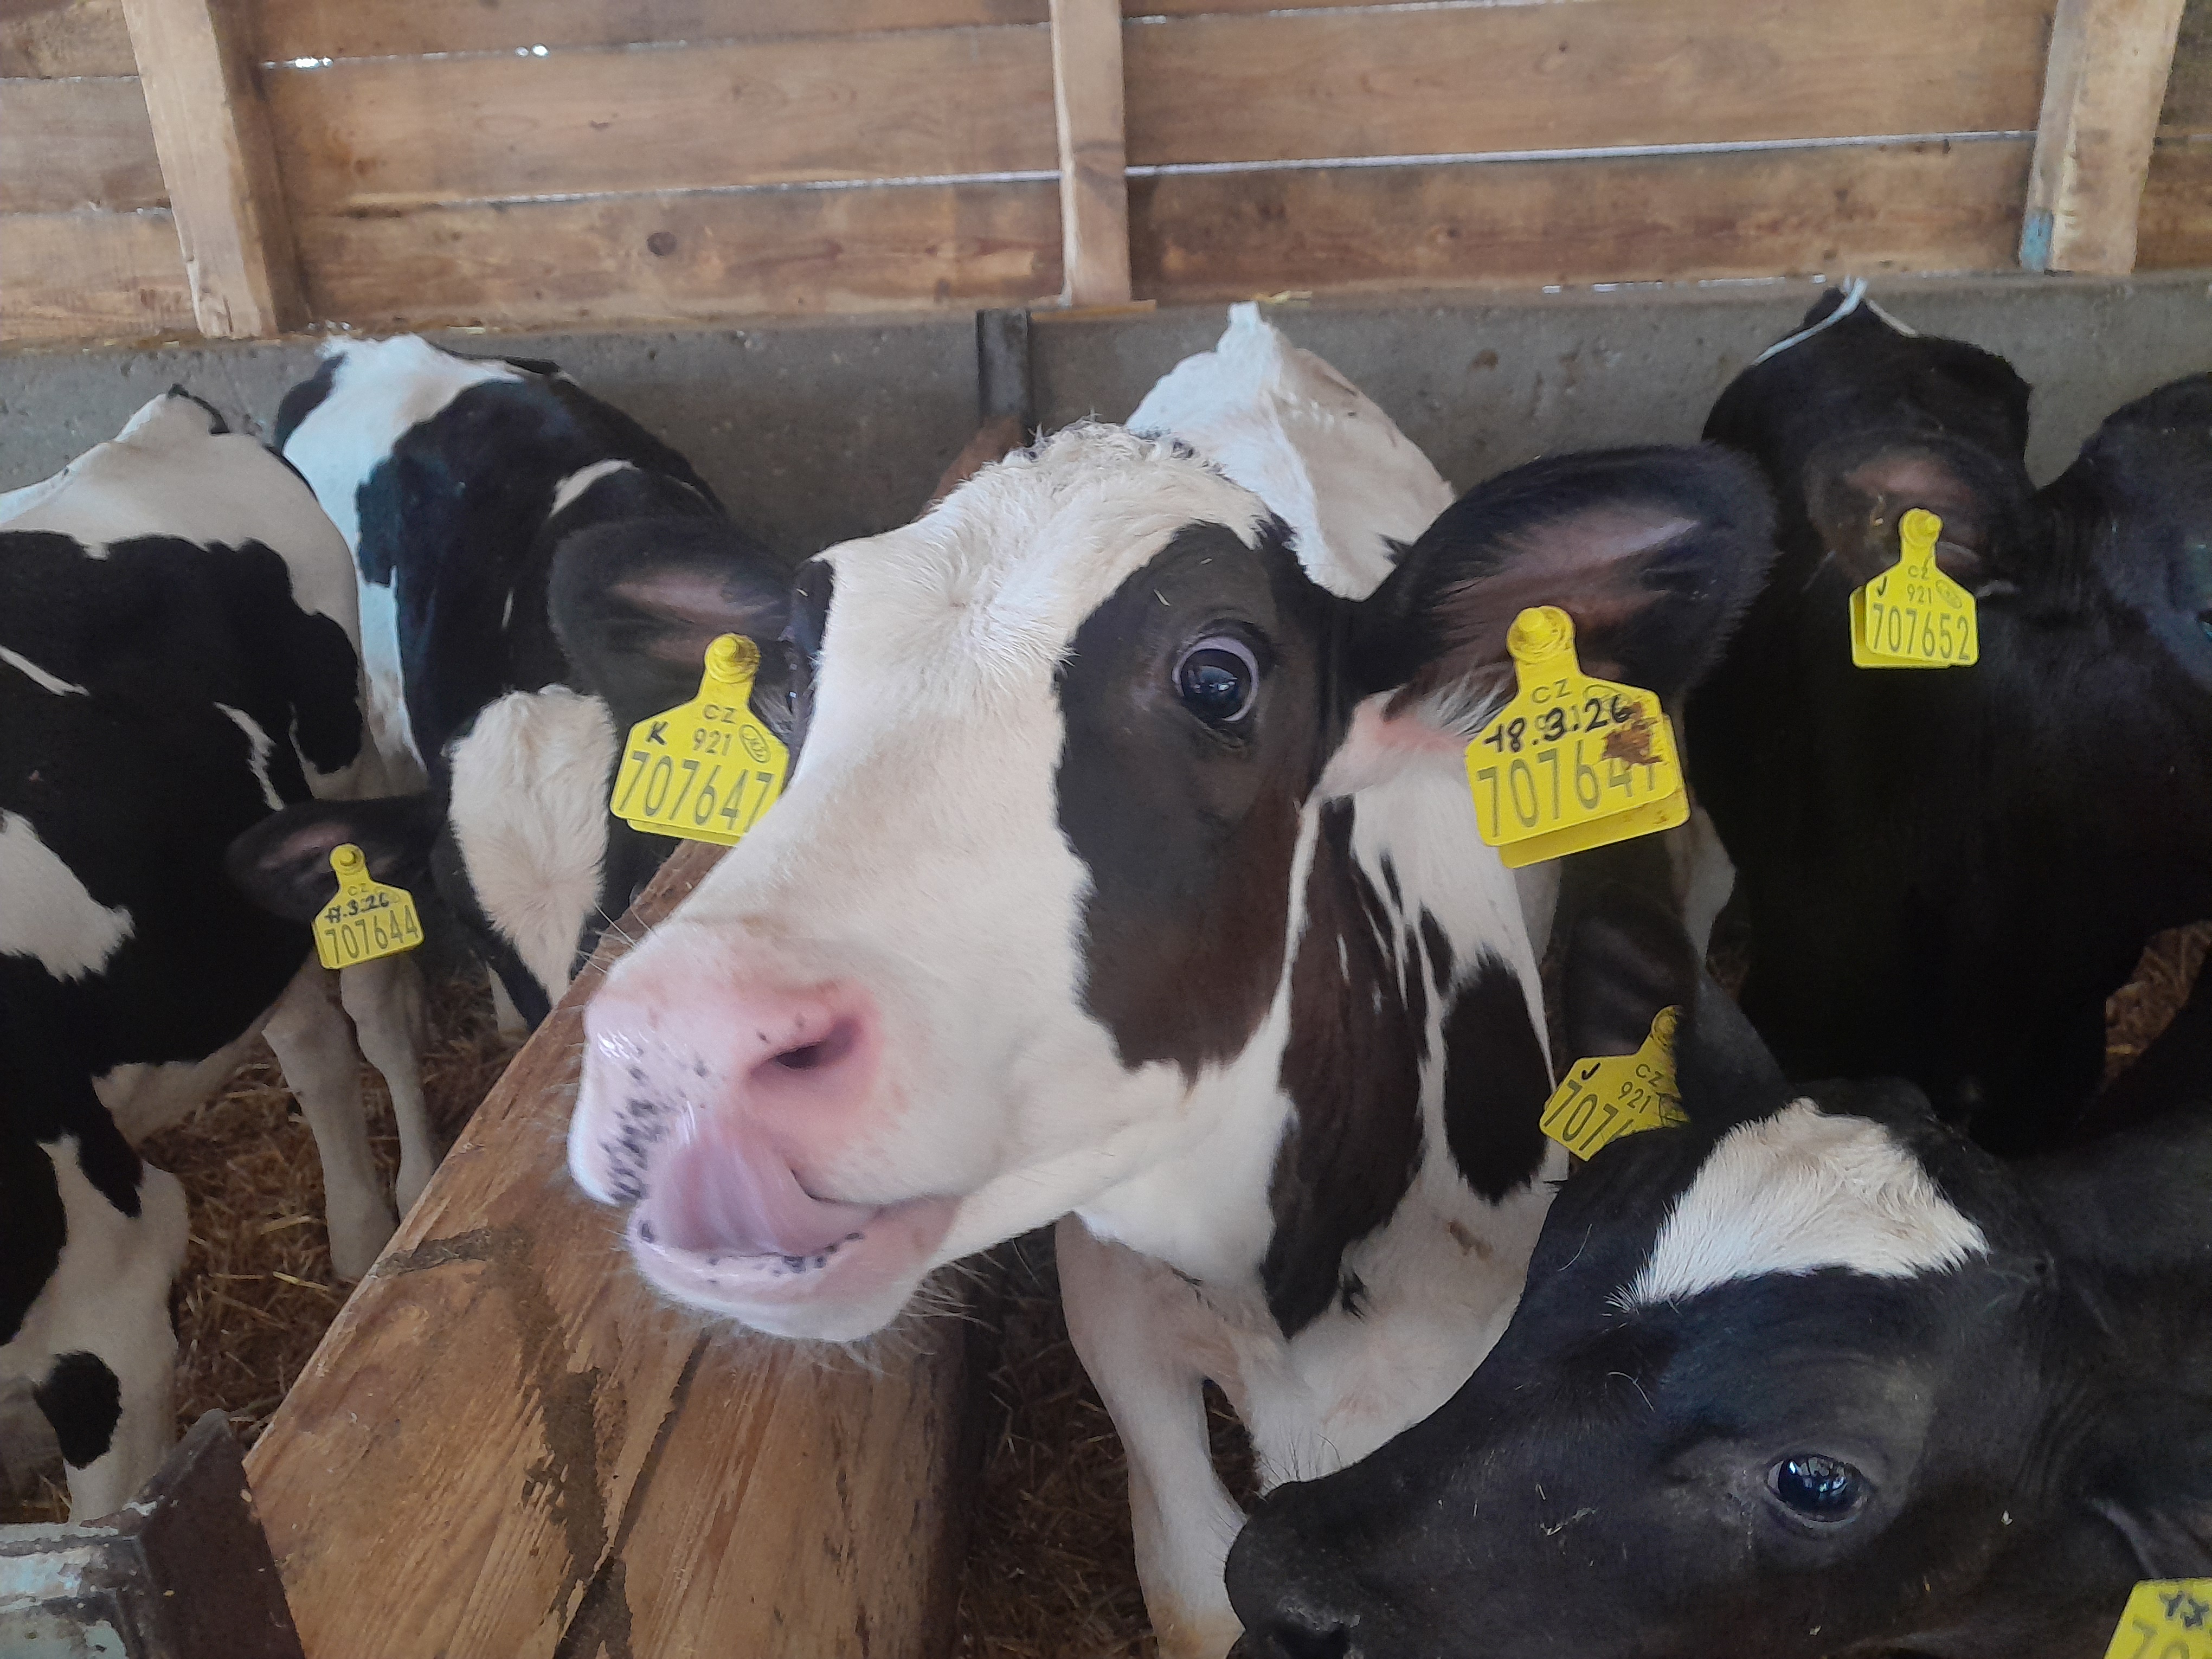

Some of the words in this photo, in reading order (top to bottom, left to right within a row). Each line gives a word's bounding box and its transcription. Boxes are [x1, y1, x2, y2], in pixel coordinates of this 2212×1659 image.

[1907, 584, 1932, 605] 921
[1873, 603, 1970, 661] 707652
[1531, 678, 1571, 704] CZ
[703, 704, 736, 724] CZ
[646, 721, 668, 745] K
[693, 728, 732, 756] 921
[618, 750, 775, 832] 707647
[326, 905, 419, 963] 707644
[1635, 1064, 1664, 1088] CZ
[1618, 1082, 1651, 1114] 921
